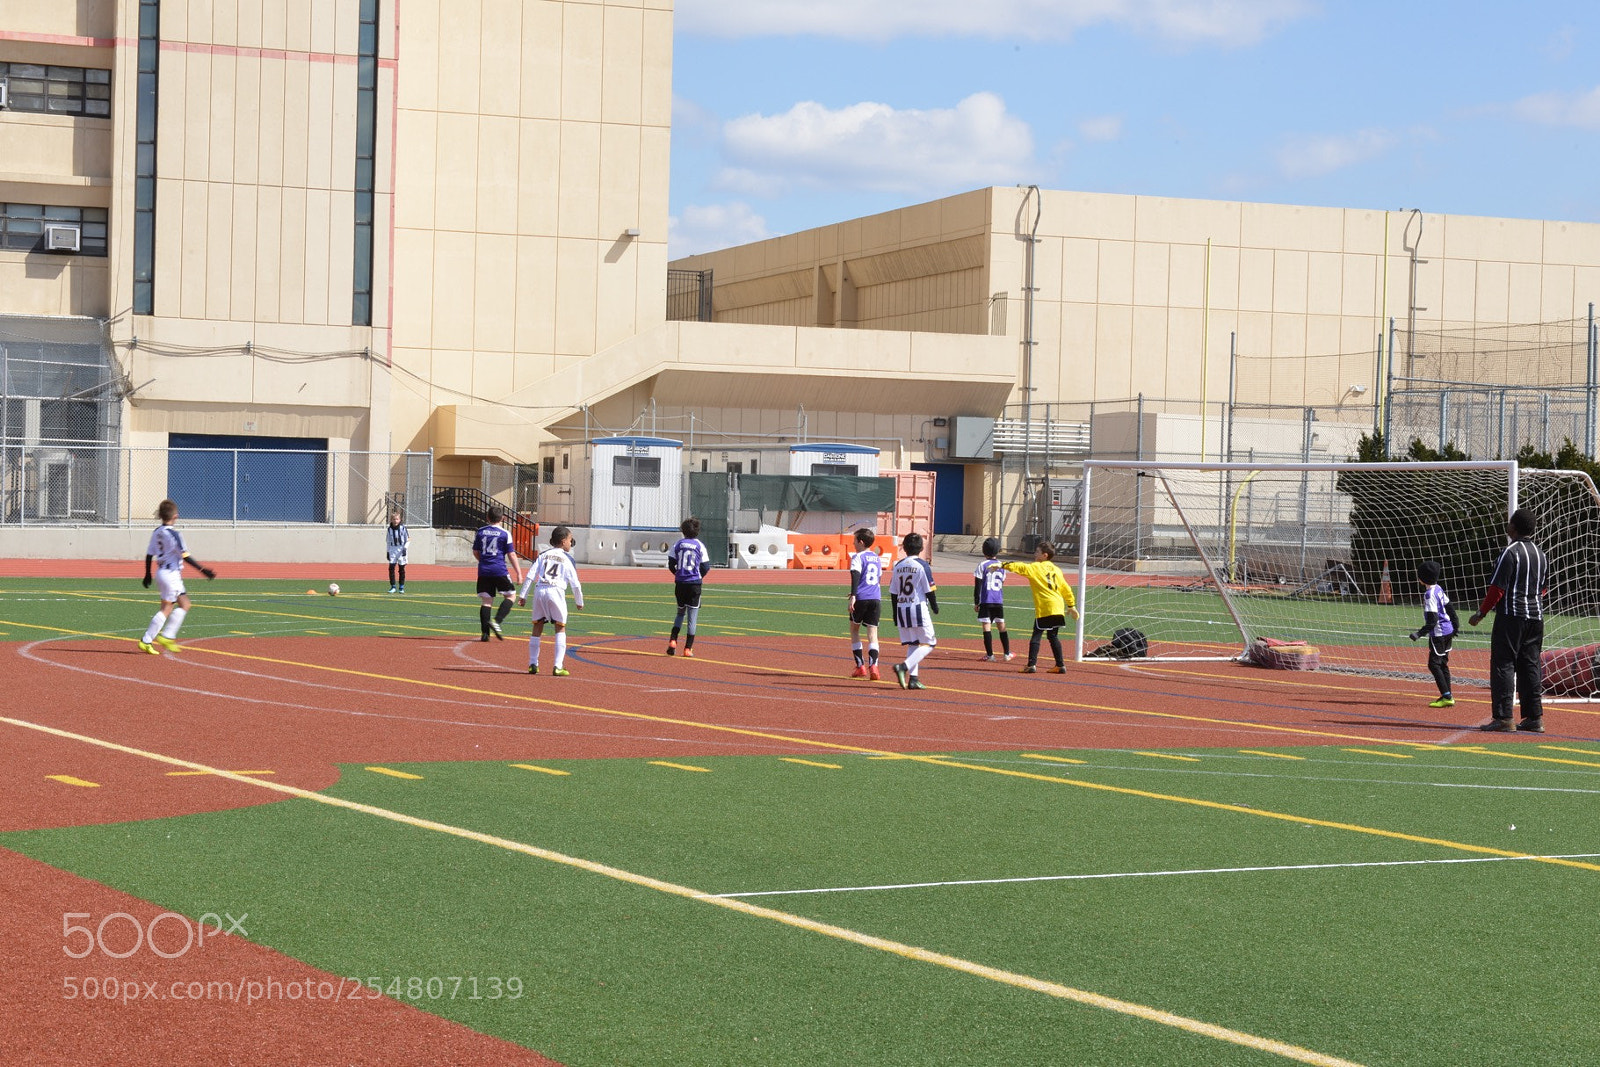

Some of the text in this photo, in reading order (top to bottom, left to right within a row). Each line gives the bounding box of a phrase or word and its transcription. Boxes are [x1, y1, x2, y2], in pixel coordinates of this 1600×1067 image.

[481, 536, 498, 555] 14
[677, 550, 696, 570] 10
[542, 562, 559, 580] 14
[865, 563, 879, 585] 8
[986, 571, 1003, 591] 16
[899, 575, 914, 596] 16
[1046, 572, 1058, 591] 11
